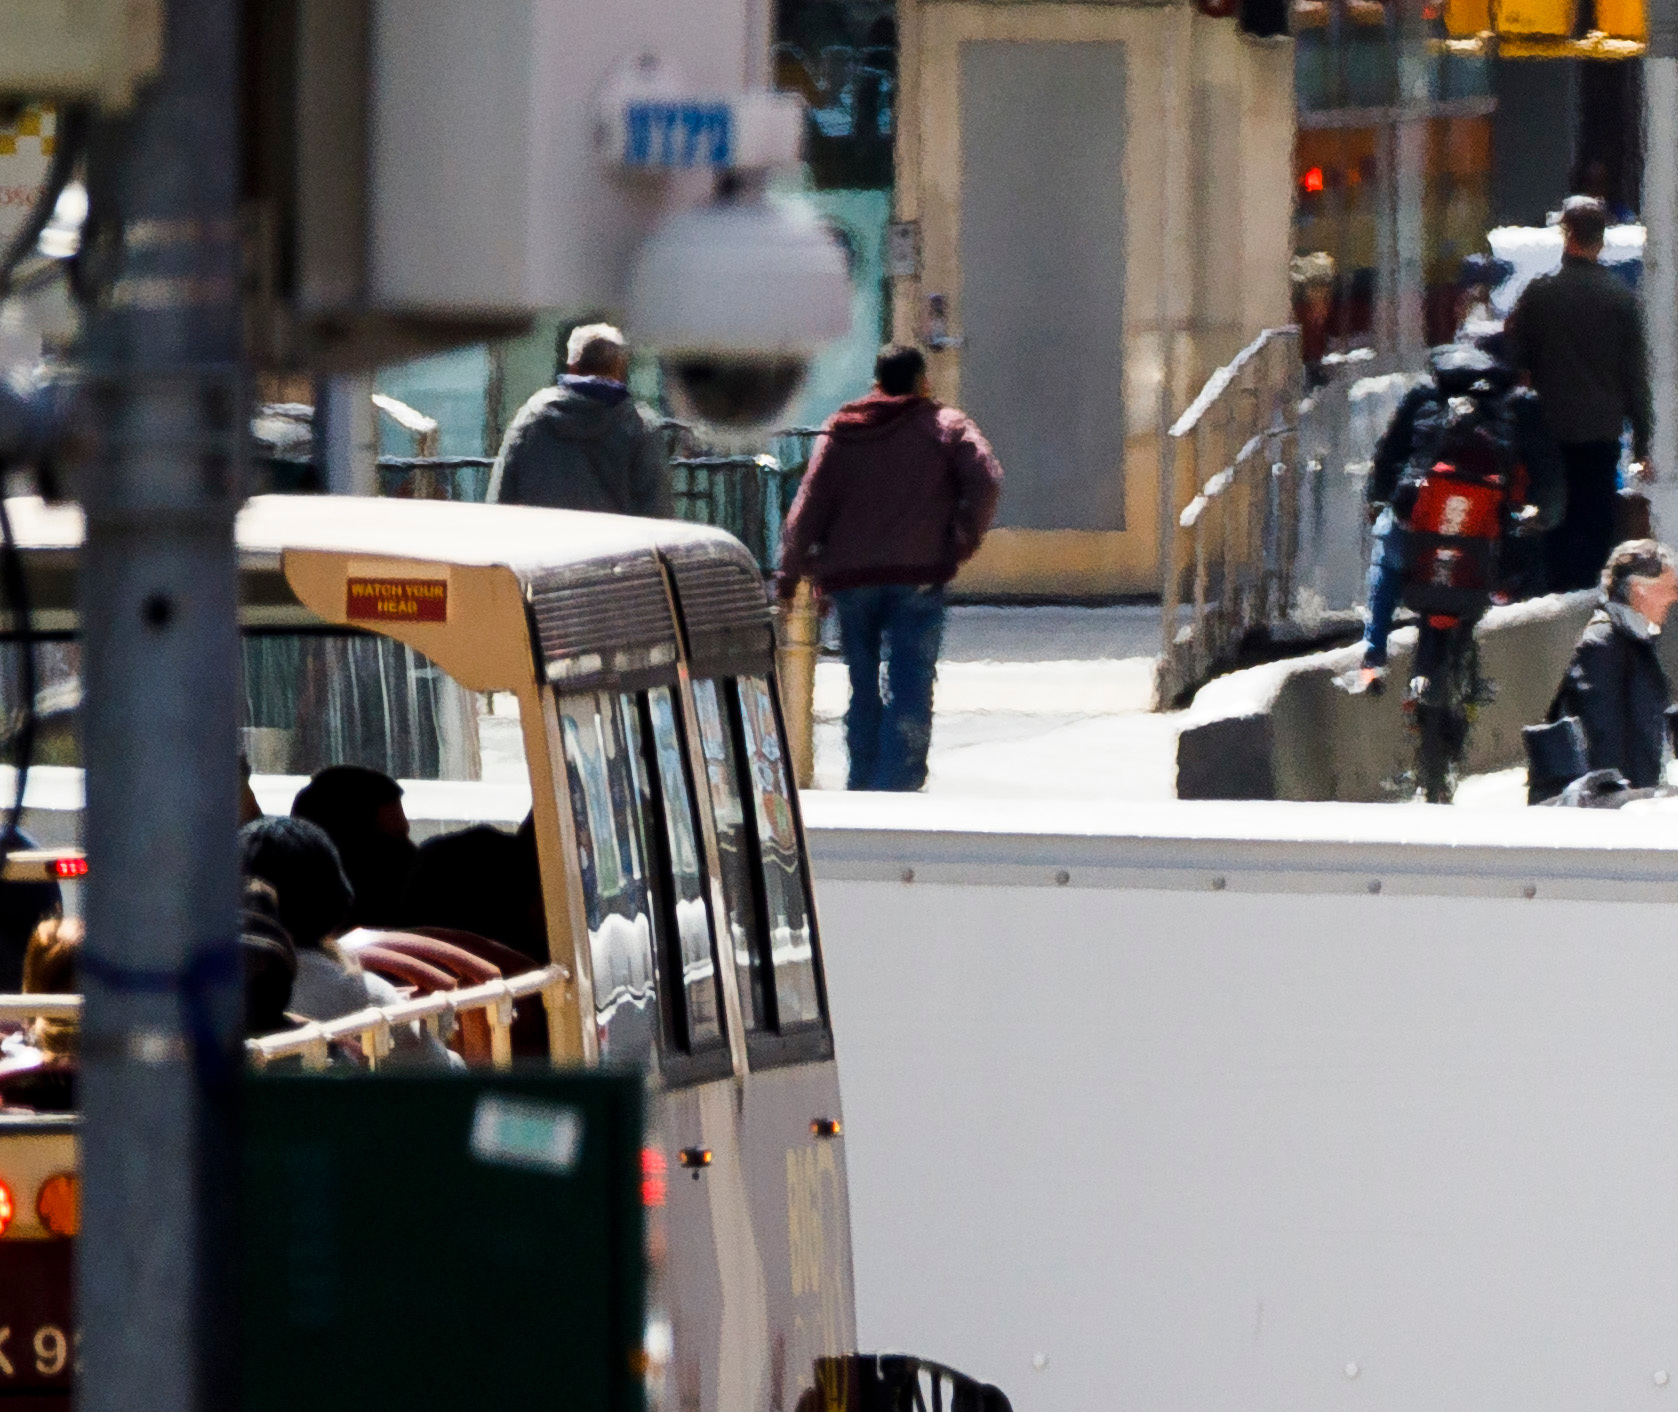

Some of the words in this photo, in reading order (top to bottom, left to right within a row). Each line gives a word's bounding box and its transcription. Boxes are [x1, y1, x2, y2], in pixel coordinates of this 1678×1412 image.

[351, 583, 403, 599] WATCH
[405, 584, 445, 600] YOUR
[377, 602, 419, 614] HEAD
